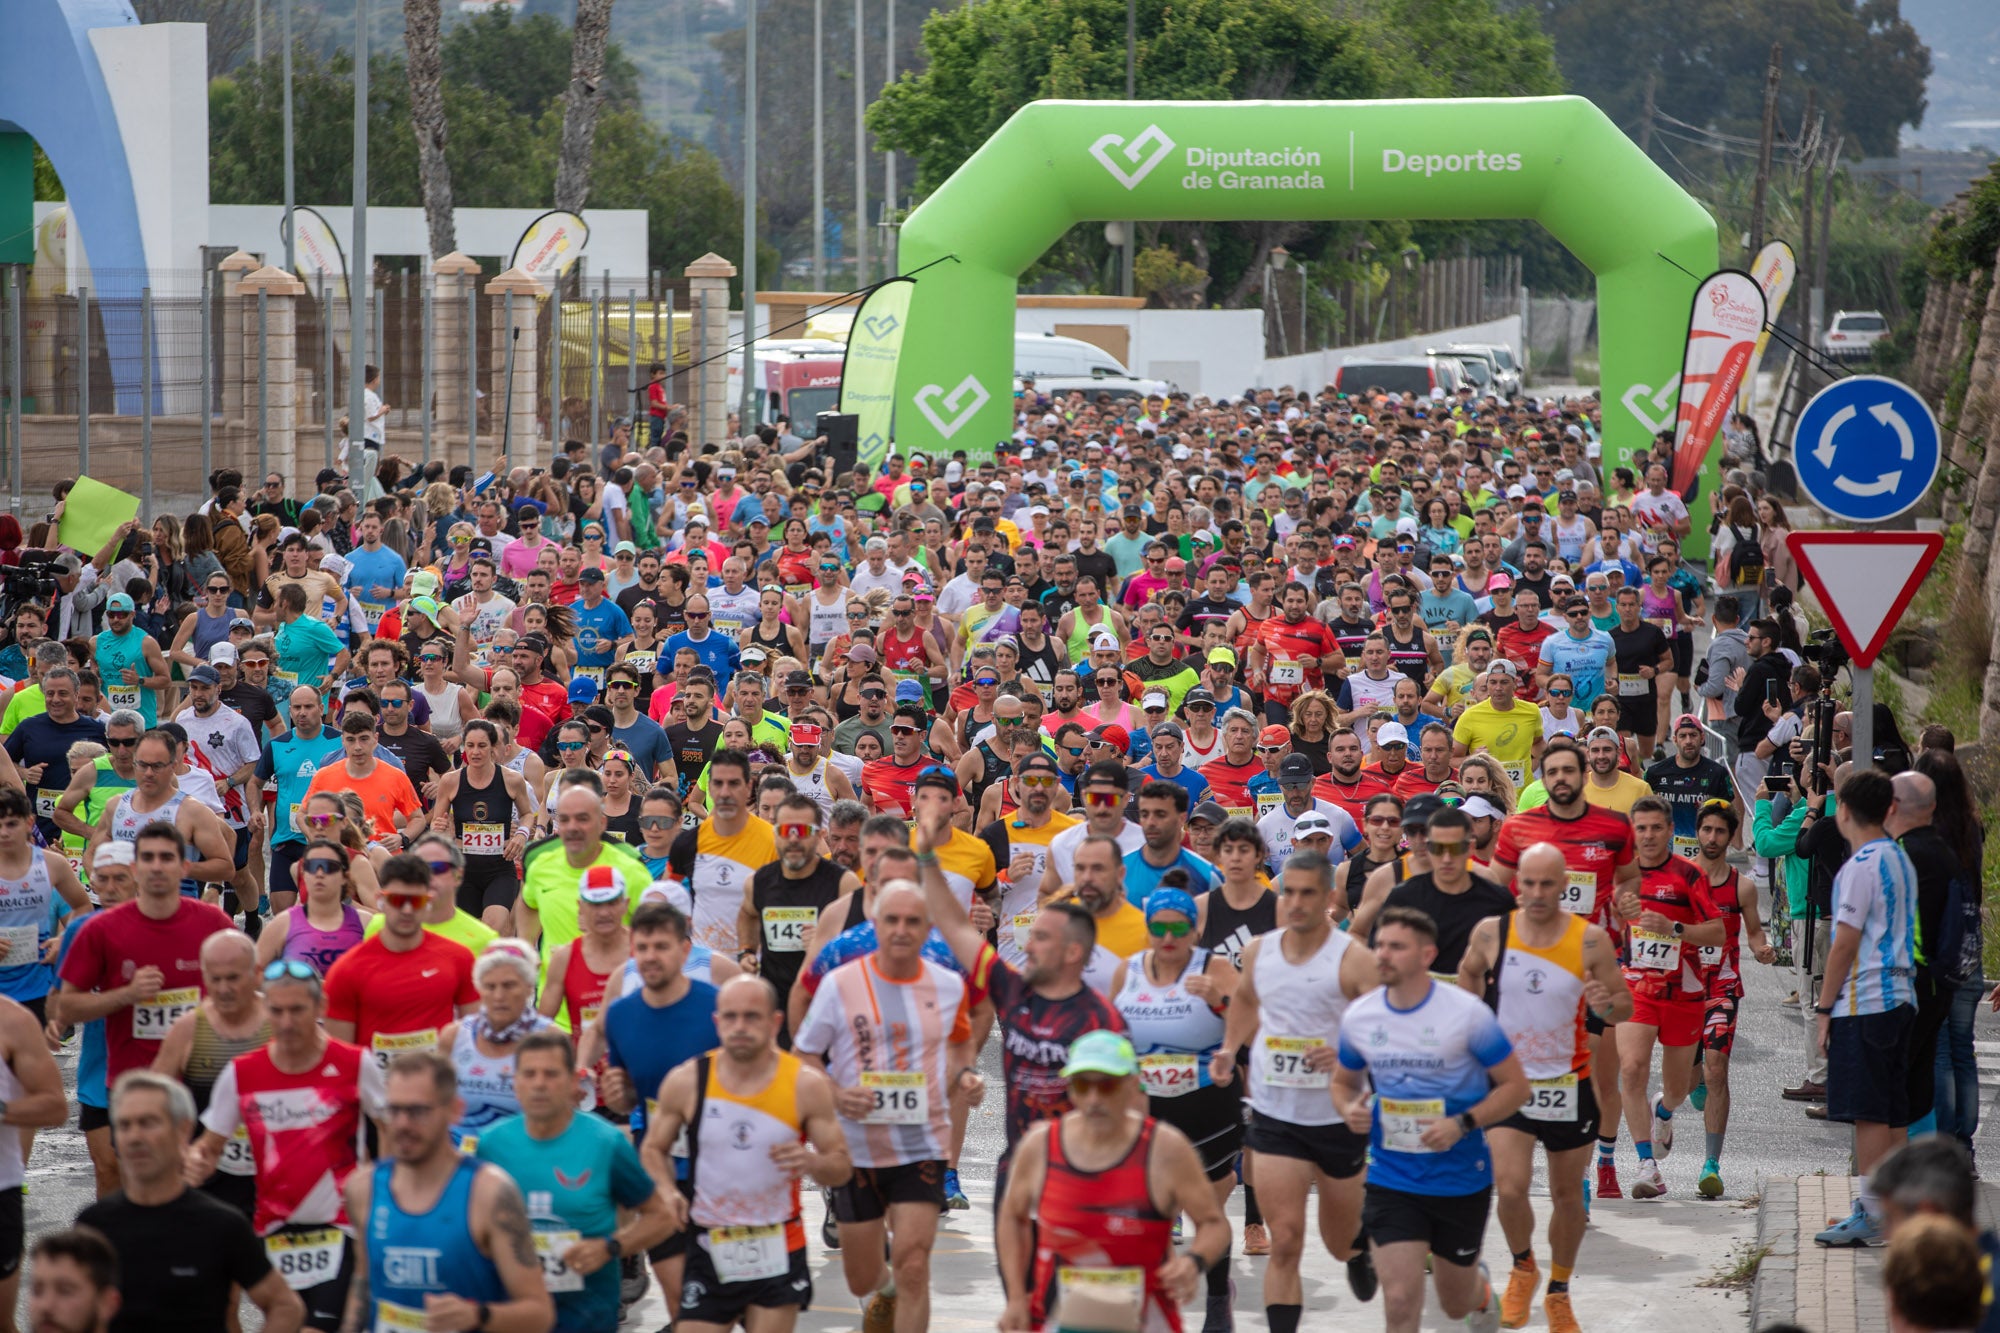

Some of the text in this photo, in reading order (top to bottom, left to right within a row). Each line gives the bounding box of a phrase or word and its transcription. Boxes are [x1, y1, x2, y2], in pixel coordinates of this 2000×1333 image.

[1186, 147, 1321, 171] Diputación
[1382, 148, 1522, 177] Deportes
[1182, 171, 1325, 189] de Granada
[1704, 352, 1746, 428] saborgranada.es
[1425, 607, 1454, 619] NIKE
[1280, 668, 1295, 678] 72
[112, 694, 136, 705] 645
[464, 833, 502, 847] 2131
[1637, 941, 1671, 958] 147
[1123, 1004, 1193, 1017] MARACENA
[280, 1250, 329, 1275] 888
